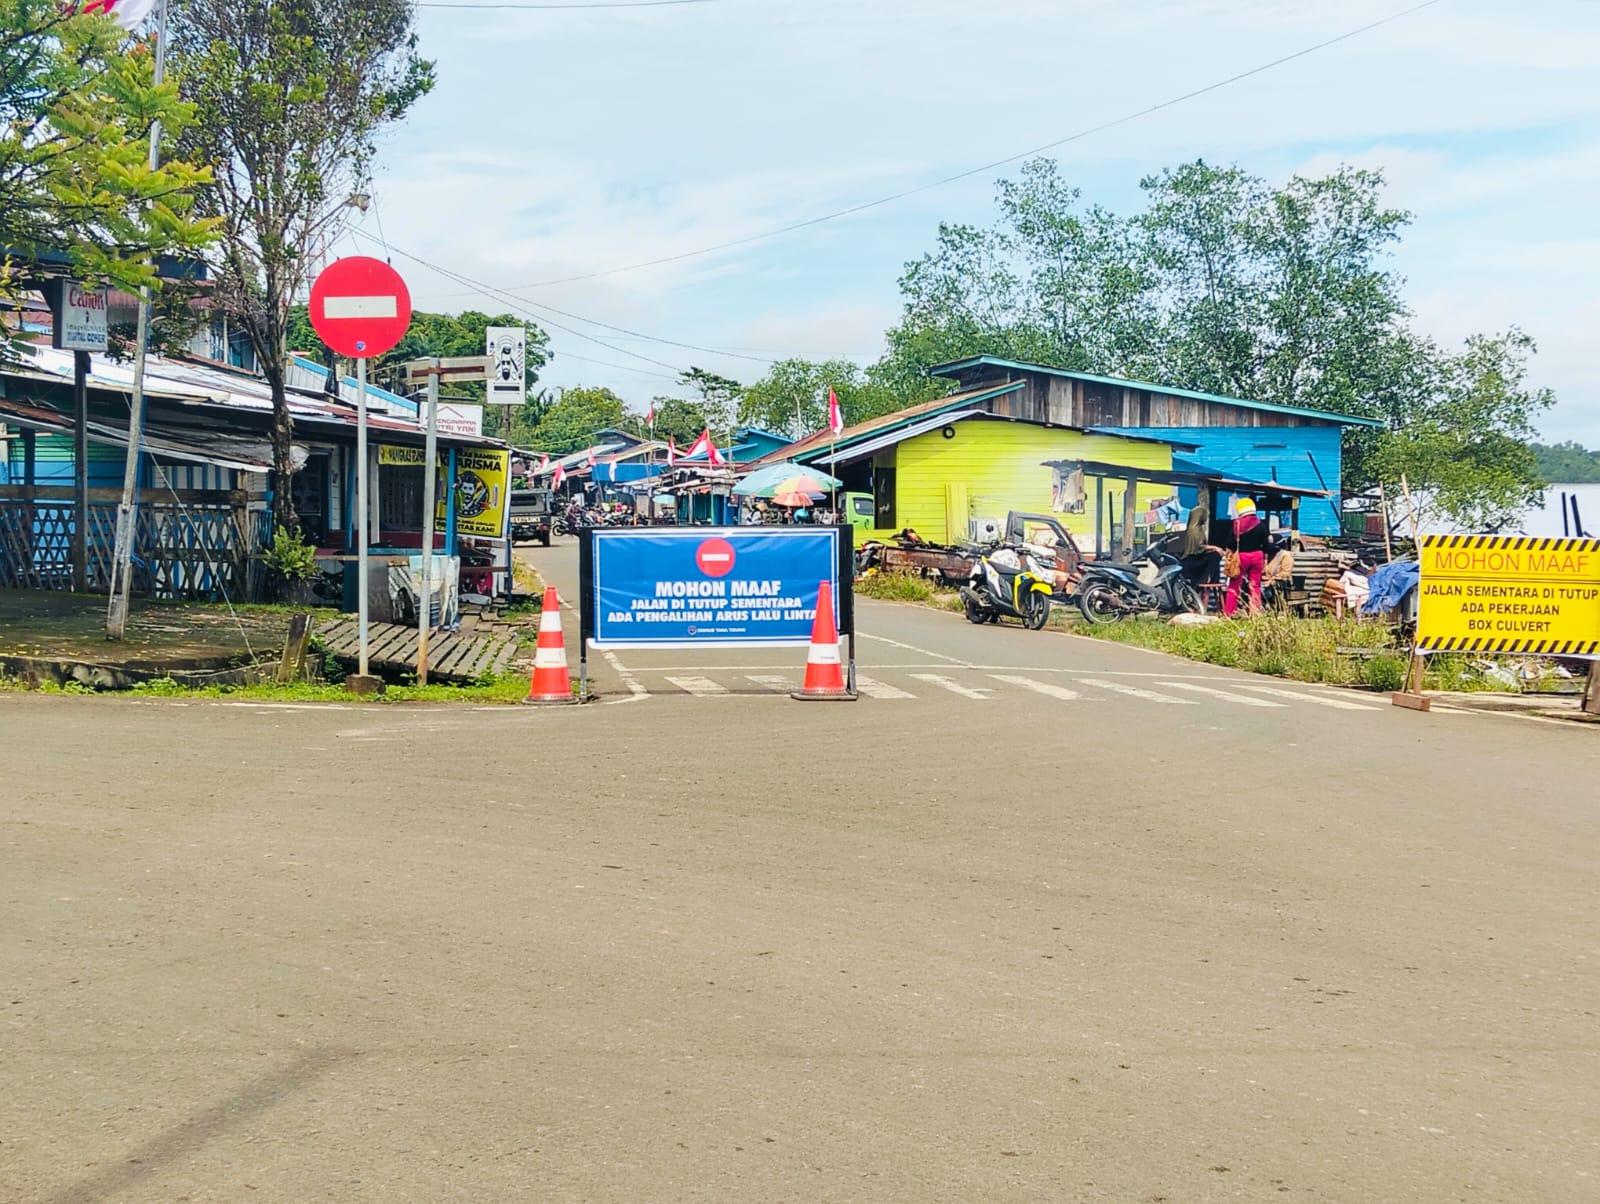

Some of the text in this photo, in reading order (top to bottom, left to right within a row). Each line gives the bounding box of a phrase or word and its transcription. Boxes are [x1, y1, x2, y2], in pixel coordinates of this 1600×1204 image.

[69, 287, 104, 310] Canon
[476, 525, 496, 533] KAMI
[1435, 551, 1590, 573] MOHON MAAF
[656, 581, 782, 597] MOHON MAAF
[1424, 585, 1599, 600] JALAN SEMENTARA DI TUTUP
[630, 597, 802, 610] JALAN DI TUTUP SEMENTARA
[1461, 602, 1560, 616] ADA PEKERJAAN
[607, 609, 816, 623] ADA PENGALIHAN ARUS LALU LINTA
[1468, 619, 1552, 632] BOX CULVERT
